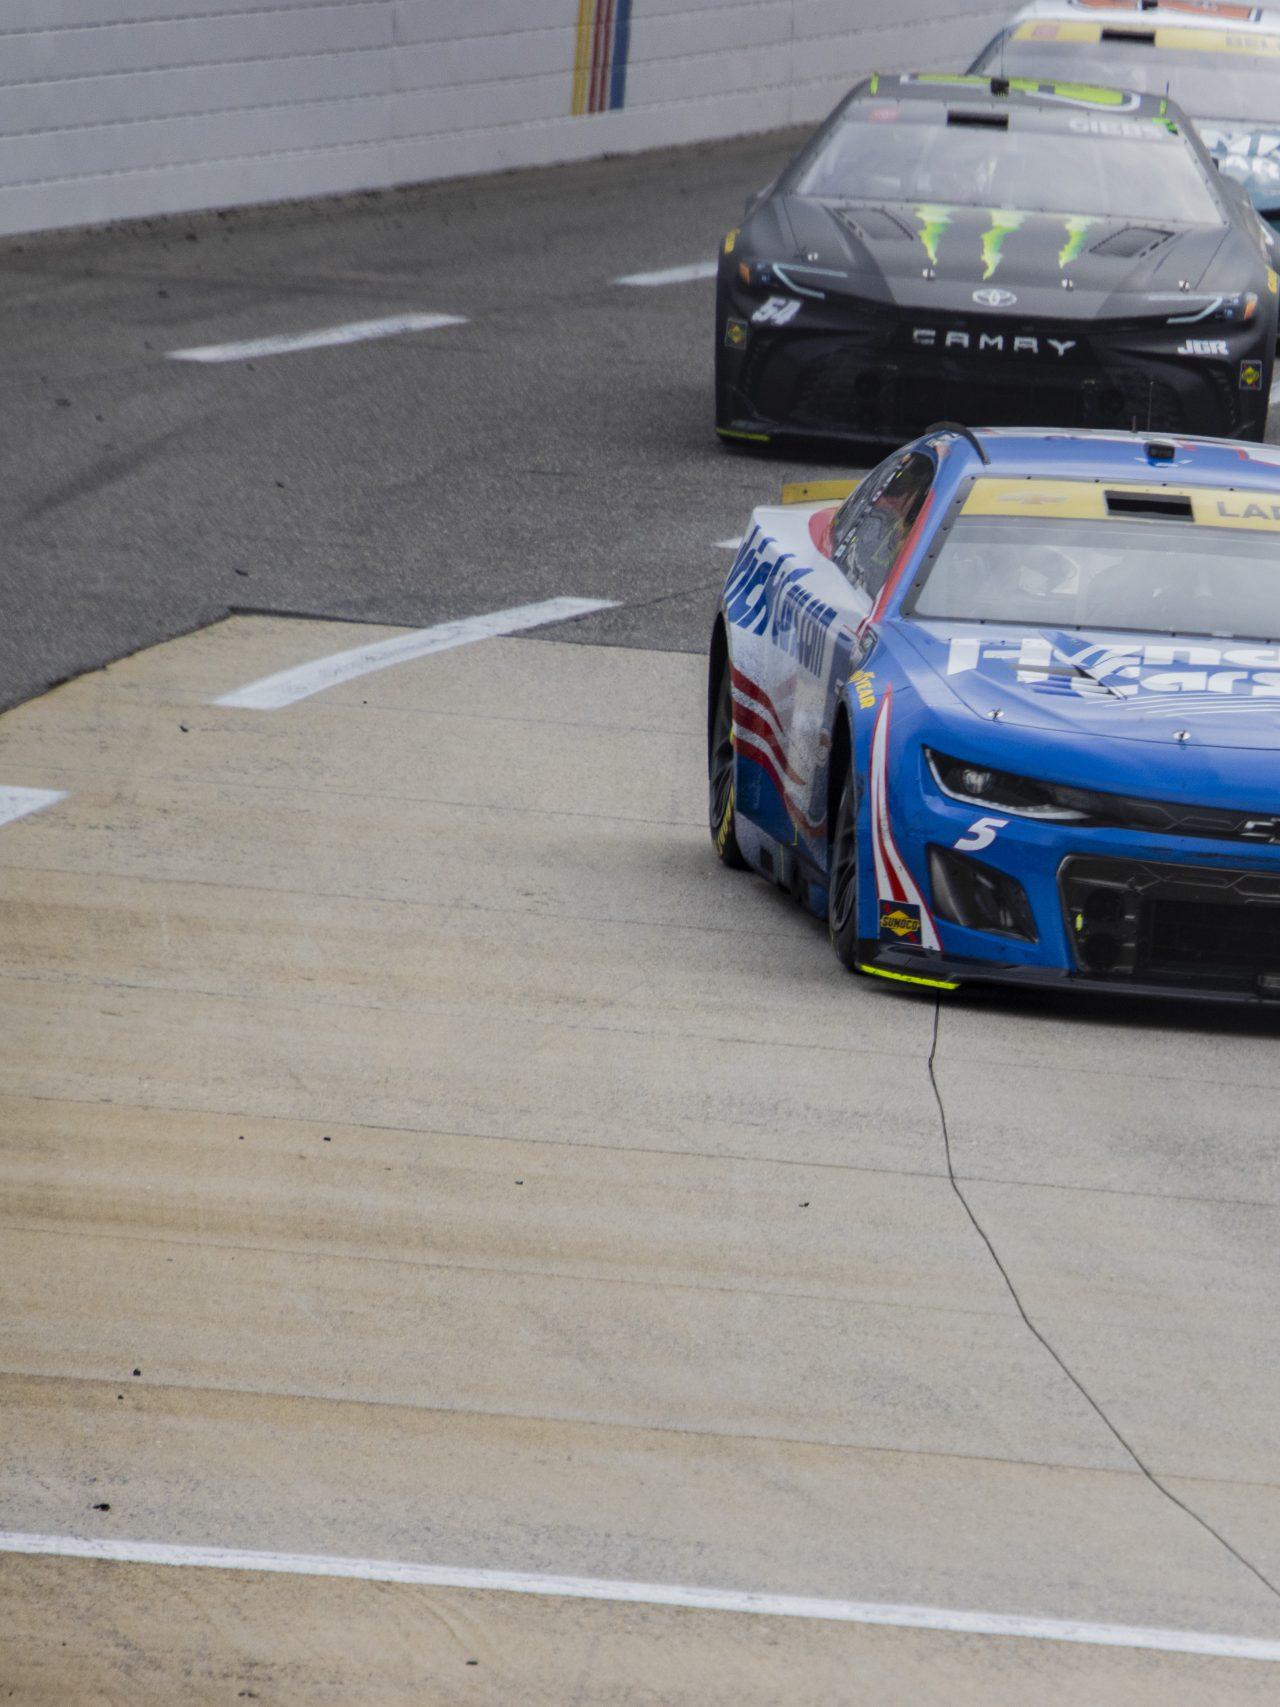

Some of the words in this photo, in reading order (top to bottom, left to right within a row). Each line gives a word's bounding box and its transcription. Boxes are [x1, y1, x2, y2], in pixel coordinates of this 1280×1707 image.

[912, 328, 1077, 357] CAMRY
[1177, 339, 1230, 355] JGR
[953, 817, 1010, 852] 5
